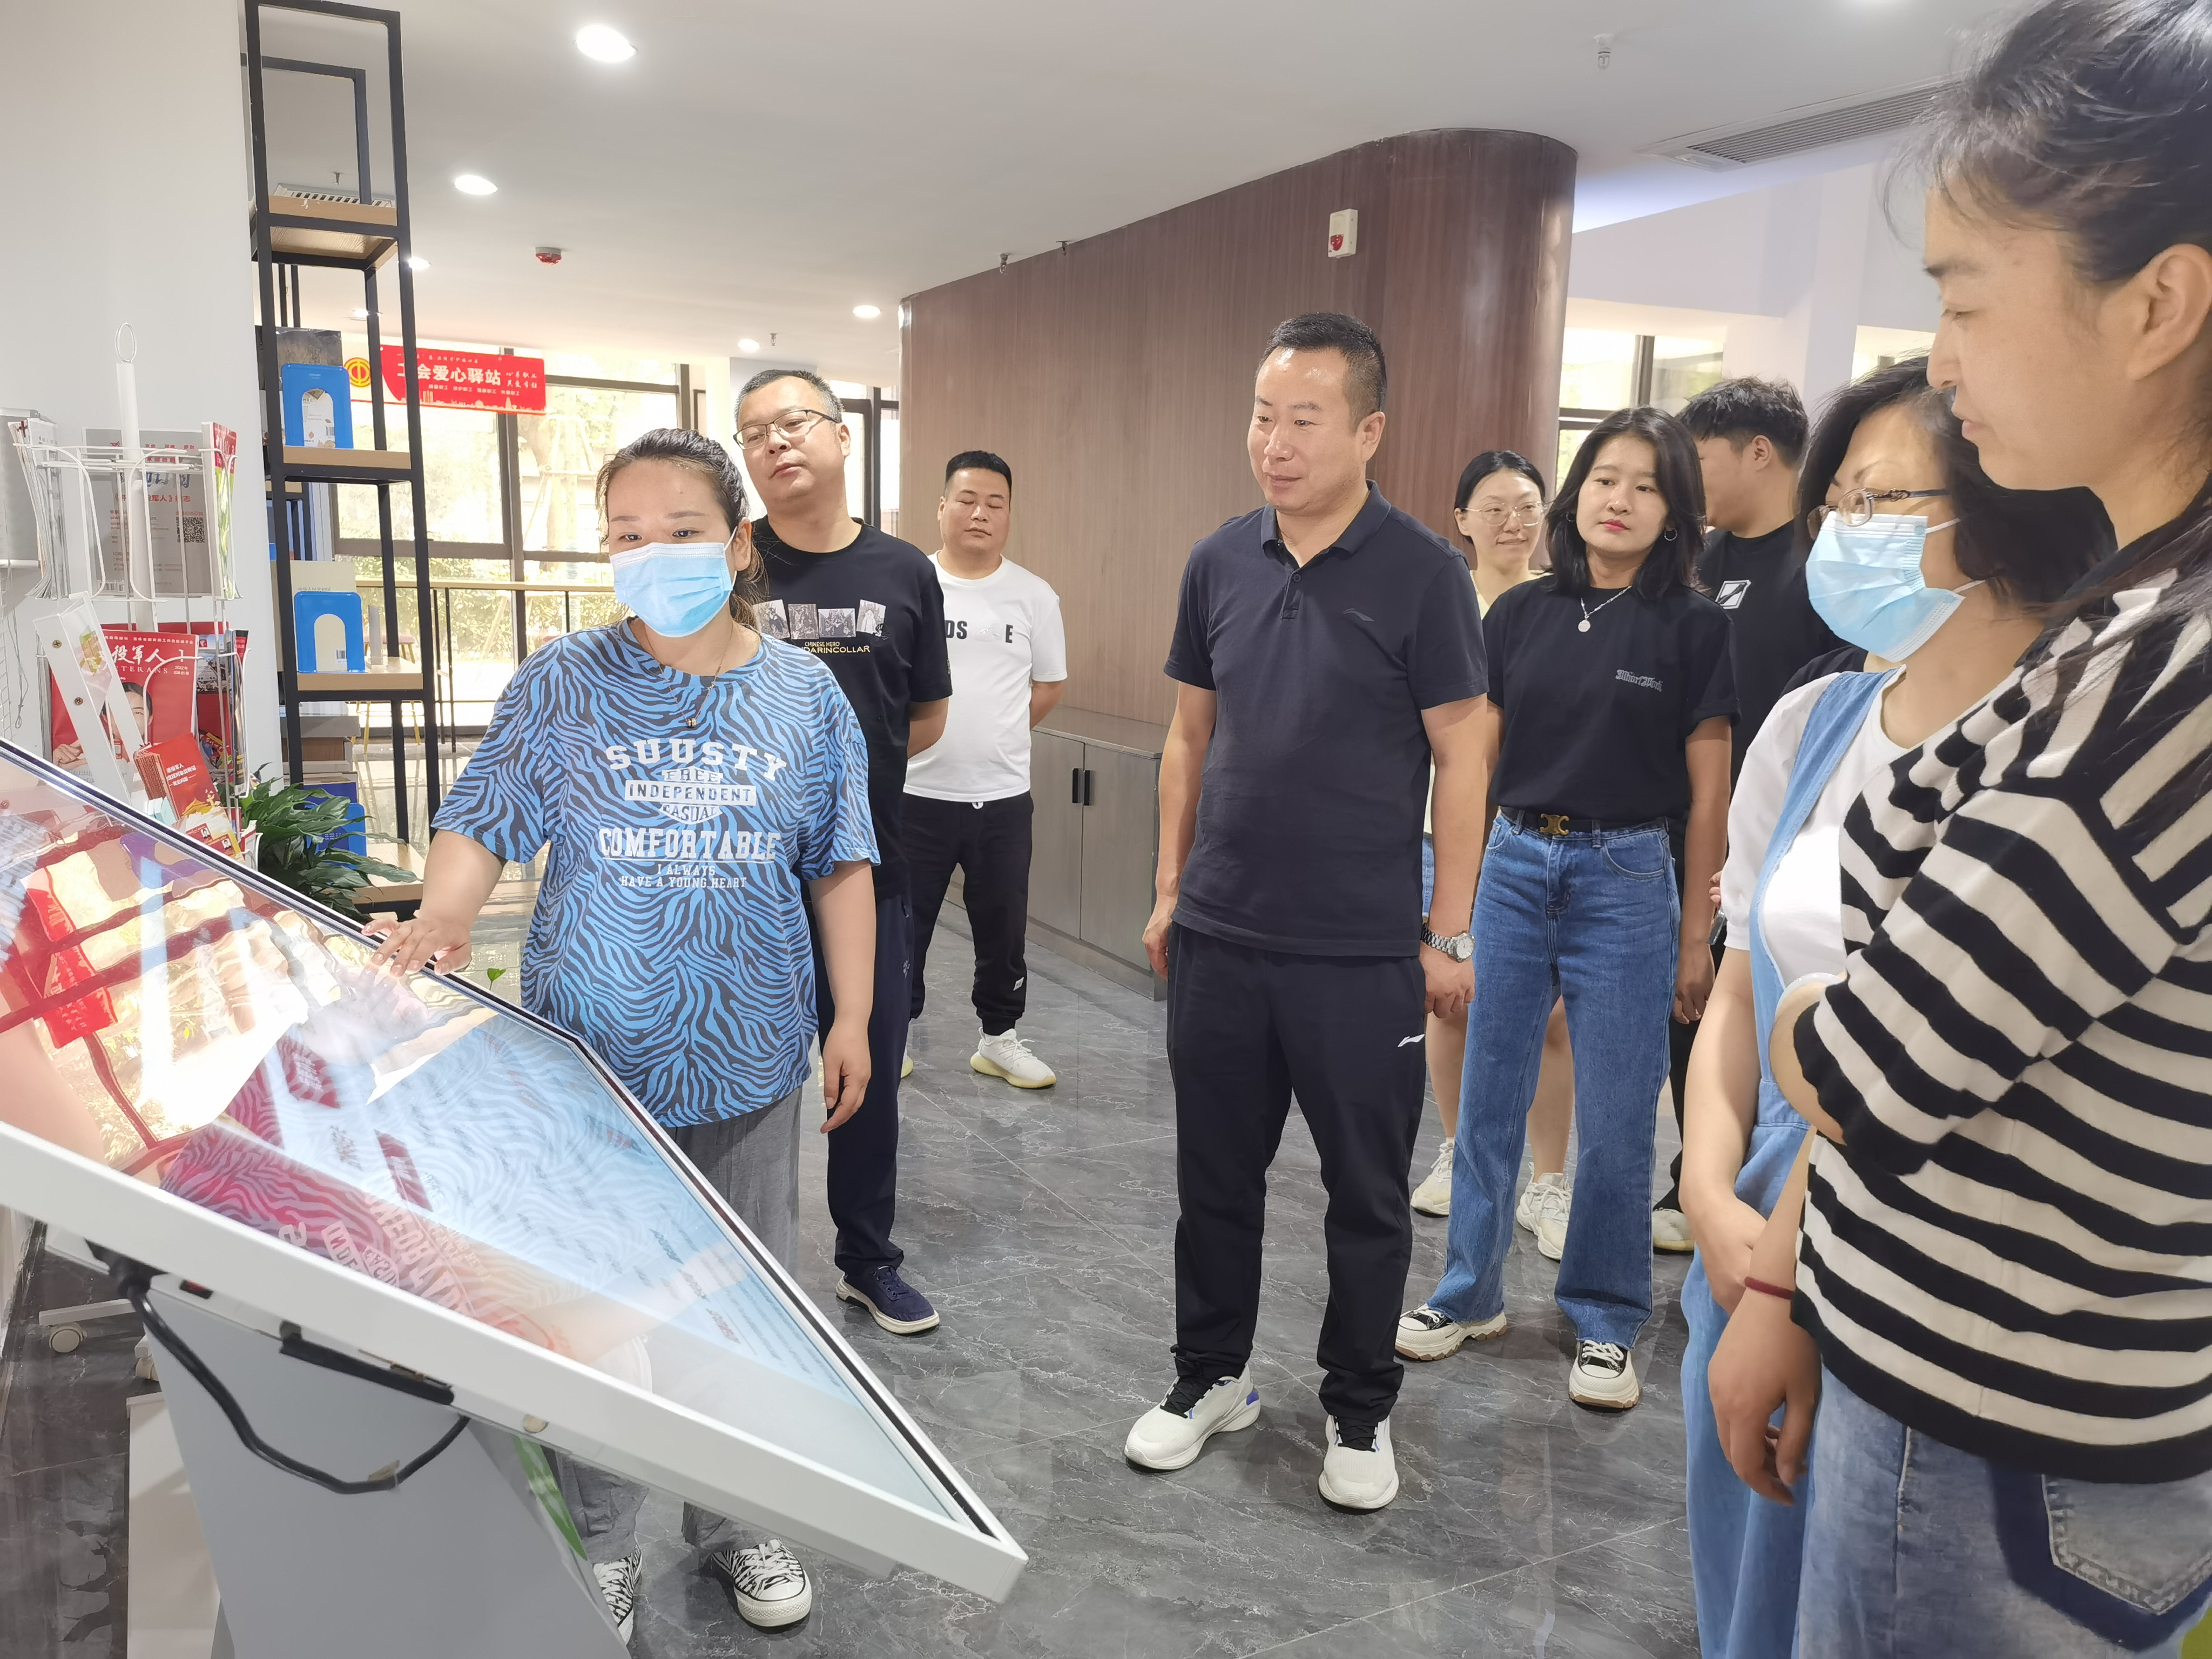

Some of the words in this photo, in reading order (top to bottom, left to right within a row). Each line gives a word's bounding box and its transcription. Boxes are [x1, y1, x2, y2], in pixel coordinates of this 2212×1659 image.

[111, 645, 165, 665] 役军人
[803, 645, 871, 654] DARINCOLLAR
[605, 738, 787, 780] SUUSTY
[666, 768, 718, 783] FREE
[630, 783, 751, 802] INDEPENDENT
[663, 804, 717, 822] CASUAL
[599, 827, 781, 860] COMFORTABLE
[657, 864, 662, 874] I
[667, 864, 716, 876] ALWAYS
[621, 875, 656, 887] HAVE
[657, 875, 664, 887] A
[669, 876, 707, 888] YOUNG
[711, 877, 747, 888] HEART
